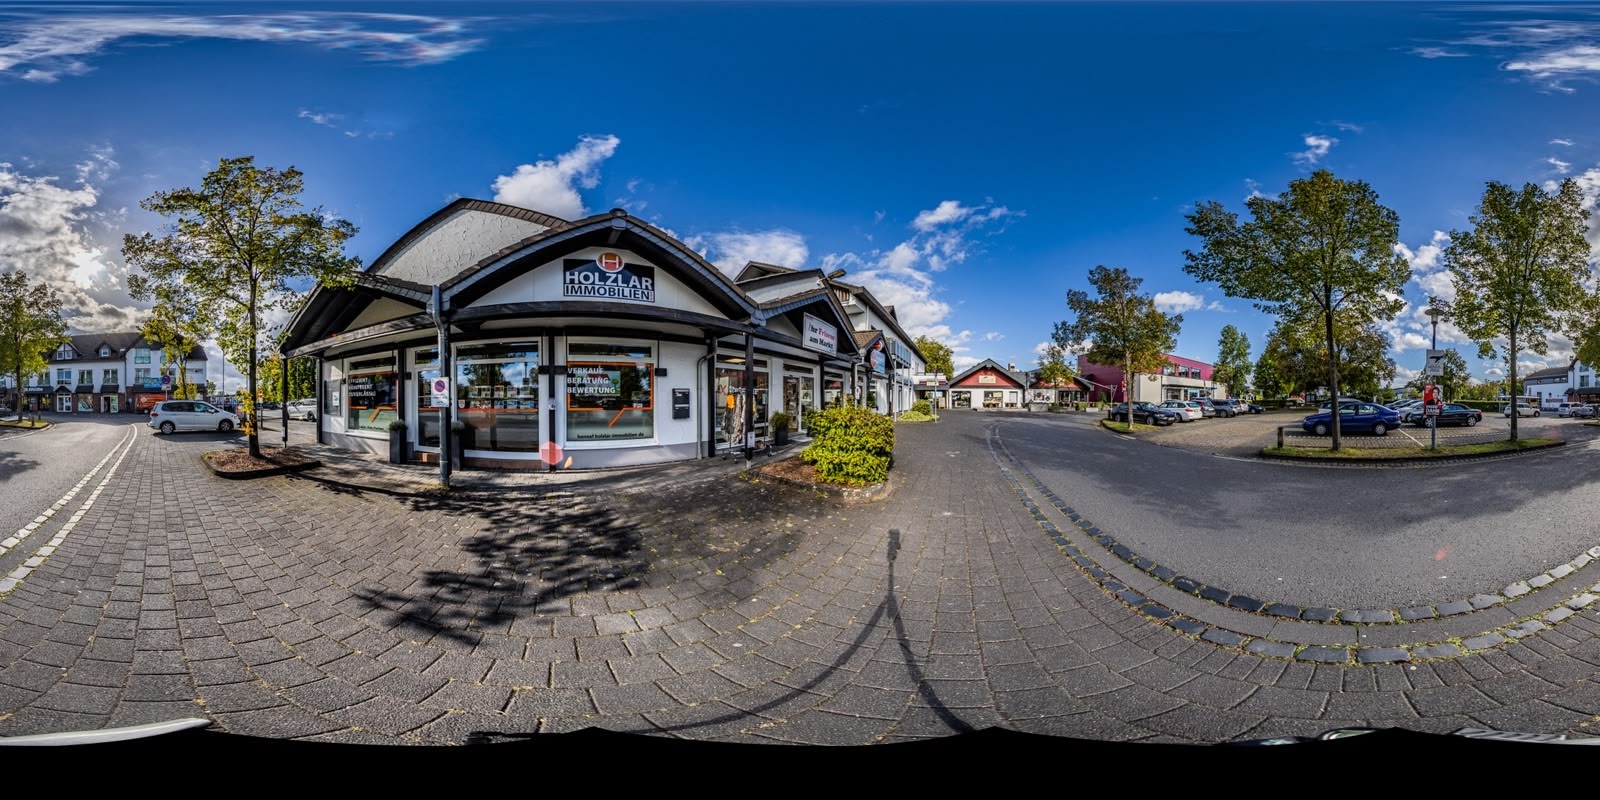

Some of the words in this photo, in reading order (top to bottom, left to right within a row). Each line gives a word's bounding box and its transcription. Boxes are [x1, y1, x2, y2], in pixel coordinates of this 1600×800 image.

[565, 271, 653, 290] HOLZLAR
[565, 284, 650, 301] IMMOBILIEN
[567, 366, 604, 374] VERKAUF
[566, 376, 609, 384] BERATUNG
[566, 386, 616, 394] BEWERTUNG
